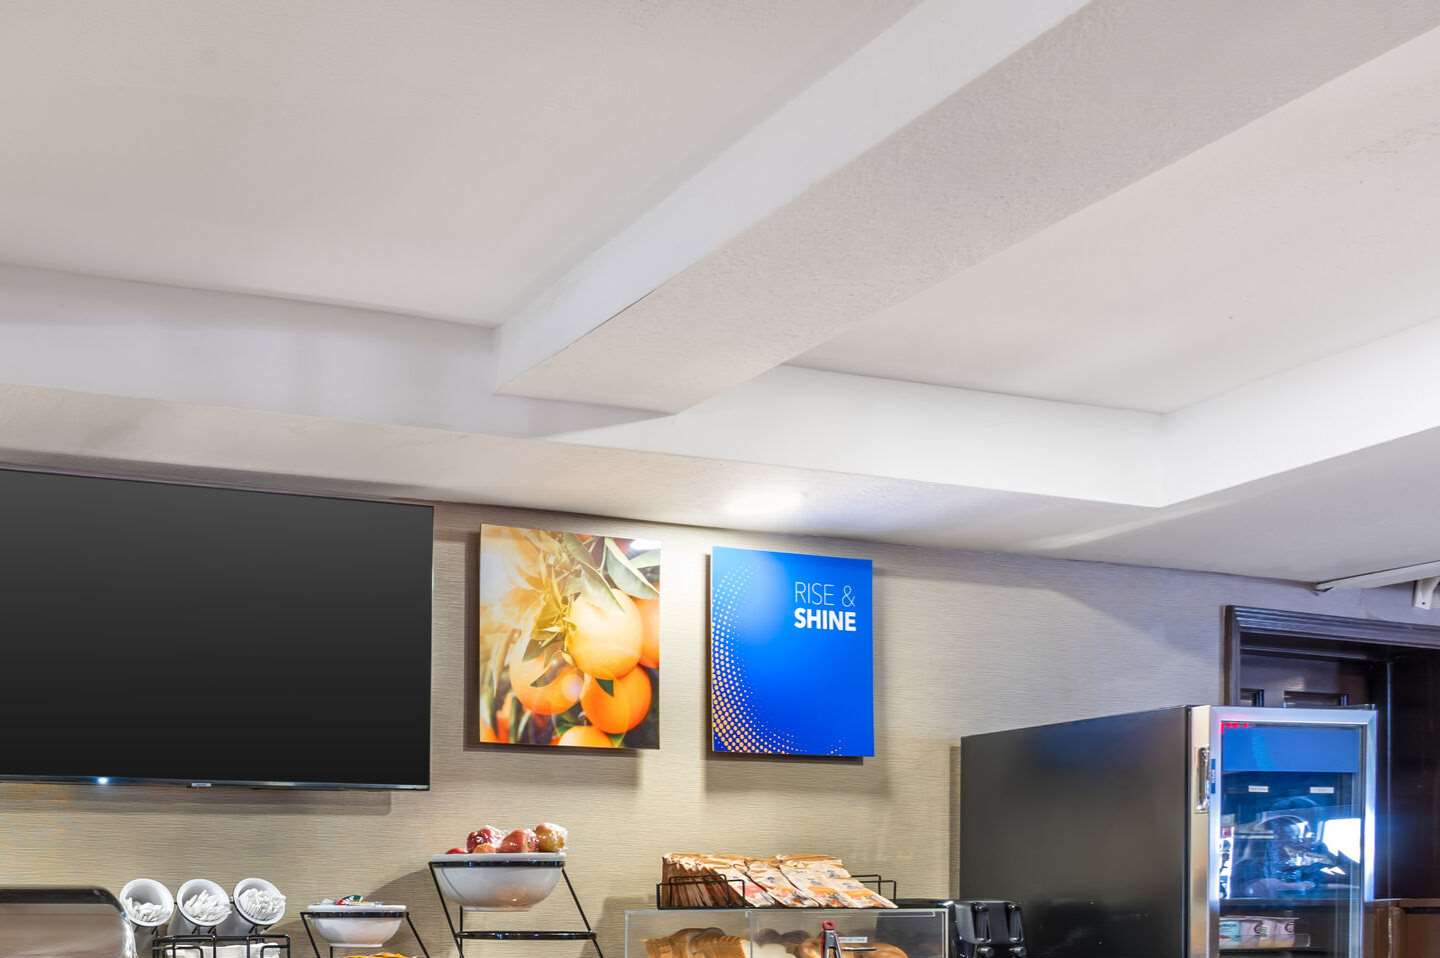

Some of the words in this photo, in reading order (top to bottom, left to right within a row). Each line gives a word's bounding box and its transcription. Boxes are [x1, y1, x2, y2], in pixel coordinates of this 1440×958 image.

[794, 581, 836, 606] RISE
[841, 585, 856, 607] &
[793, 608, 857, 632] SHINE
